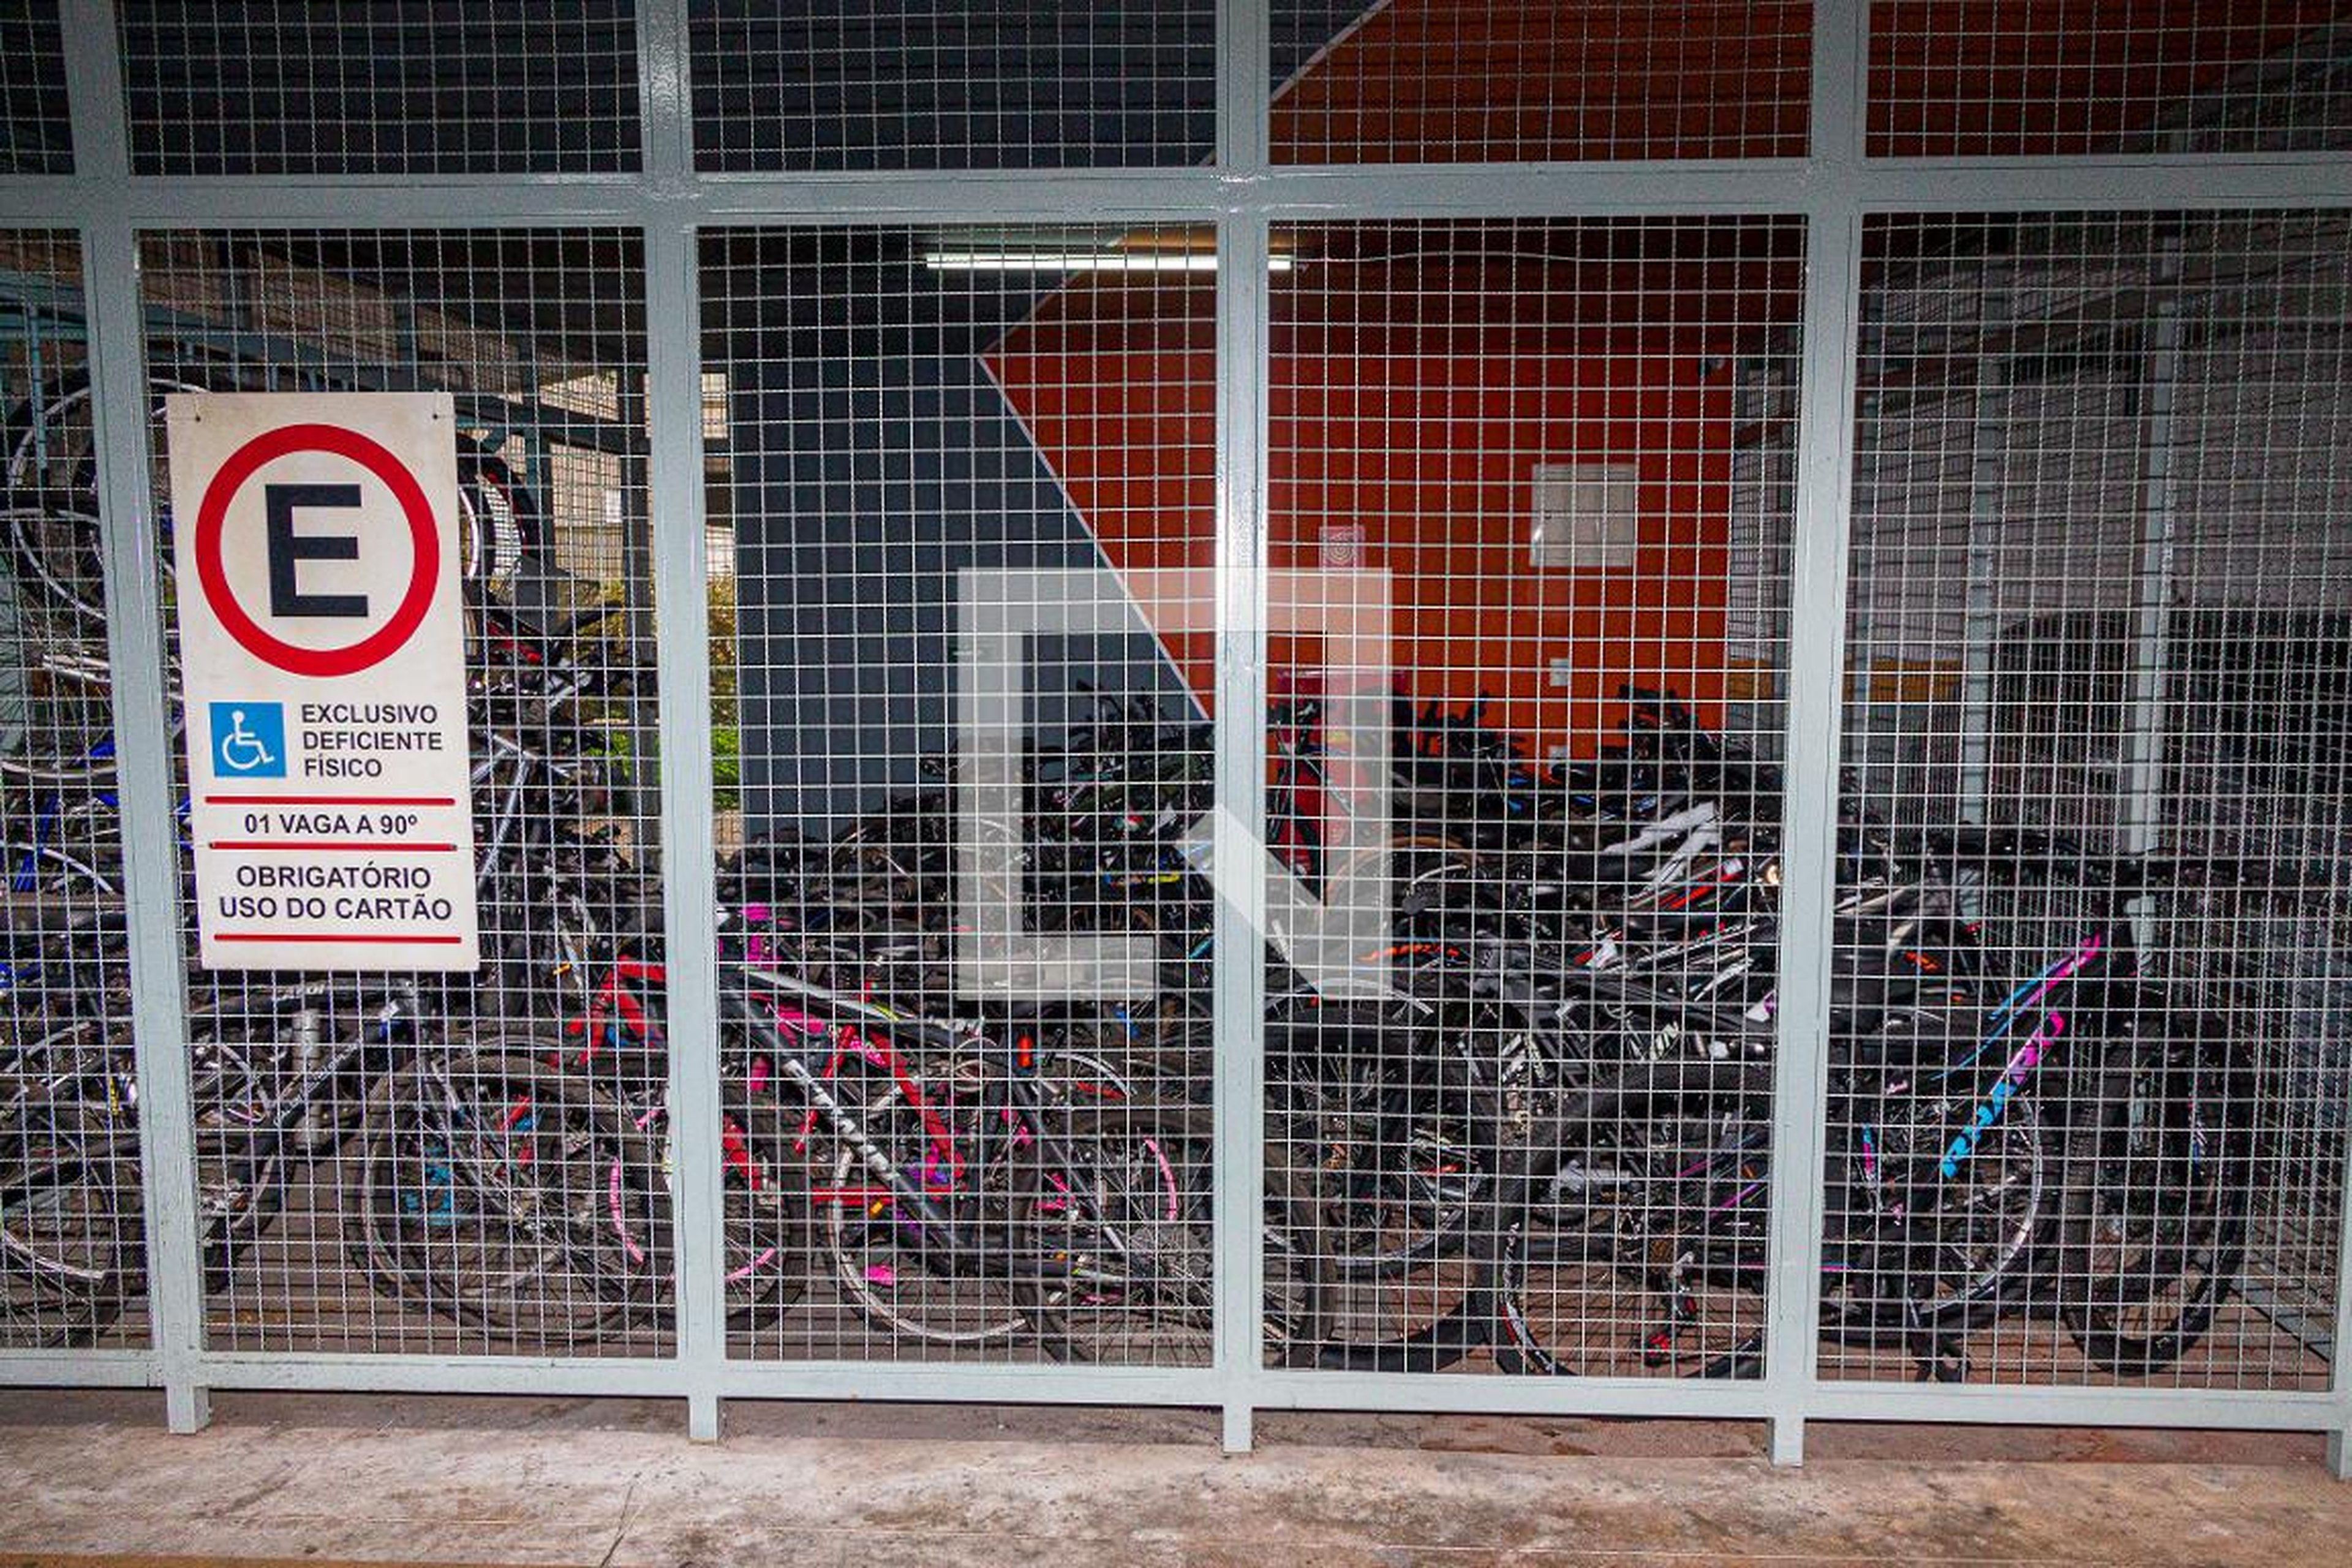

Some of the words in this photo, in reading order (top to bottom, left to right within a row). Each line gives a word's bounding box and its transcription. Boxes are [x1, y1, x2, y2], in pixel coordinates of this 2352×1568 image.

[264, 483, 369, 618] E
[301, 704, 437, 724] EXCLUSIVO
[303, 731, 442, 750] DEFICIENTE
[304, 753, 382, 777] FÍSICO
[244, 813, 270, 834] 01
[279, 814, 350, 834] VAGA
[356, 815, 374, 834] A
[236, 861, 431, 889] OBRIGATÓRIO
[219, 896, 277, 919] USO
[286, 897, 326, 919] DO
[335, 893, 451, 921] CARTÃO
